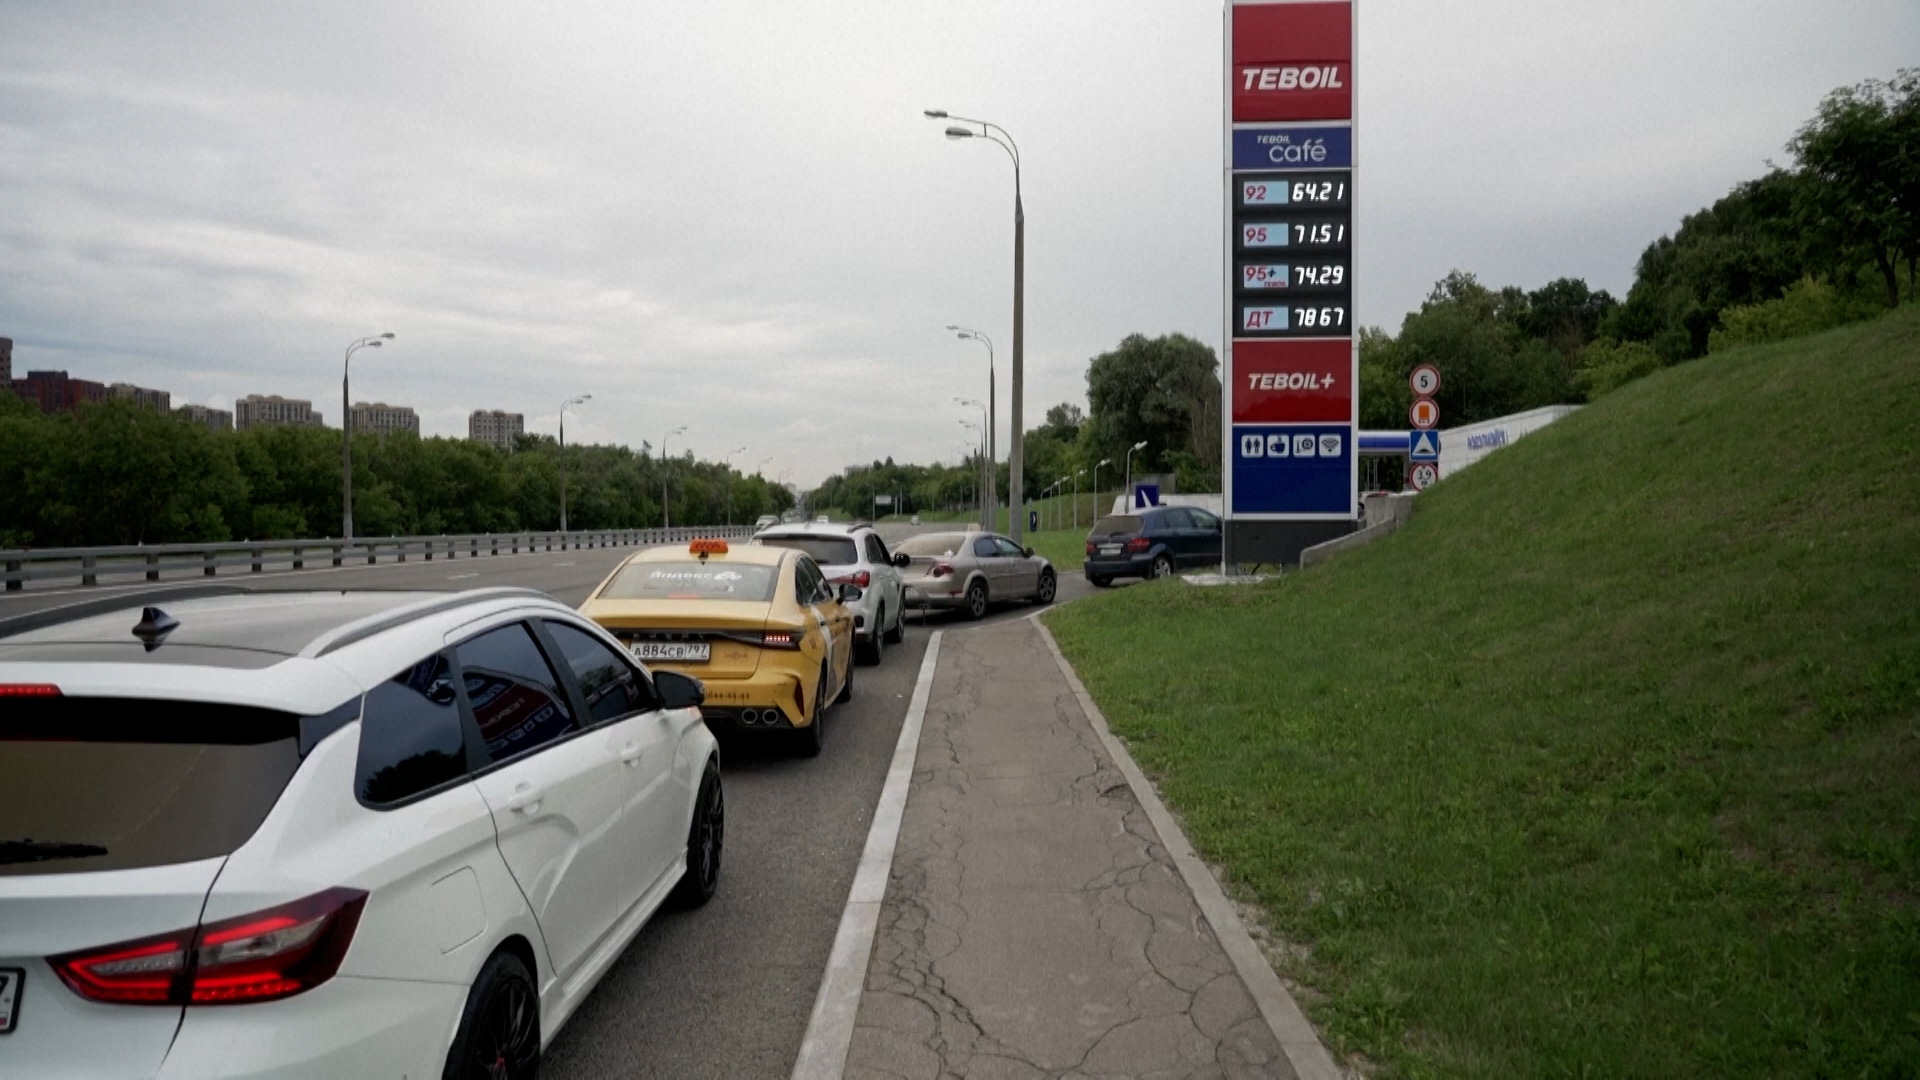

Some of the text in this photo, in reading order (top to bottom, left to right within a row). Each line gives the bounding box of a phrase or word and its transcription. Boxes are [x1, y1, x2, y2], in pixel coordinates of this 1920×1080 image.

[1242, 66, 1343, 90] TEBOIL
[1257, 135, 1290, 144] TEBOIL
[1268, 138, 1327, 162] café
[1246, 181, 1344, 202] 92 64.21
[1246, 223, 1344, 244] 95 71.51
[1294, 265, 1344, 286] 74.29
[1246, 311, 1274, 328] ДТ
[1420, 375, 1428, 388] 5
